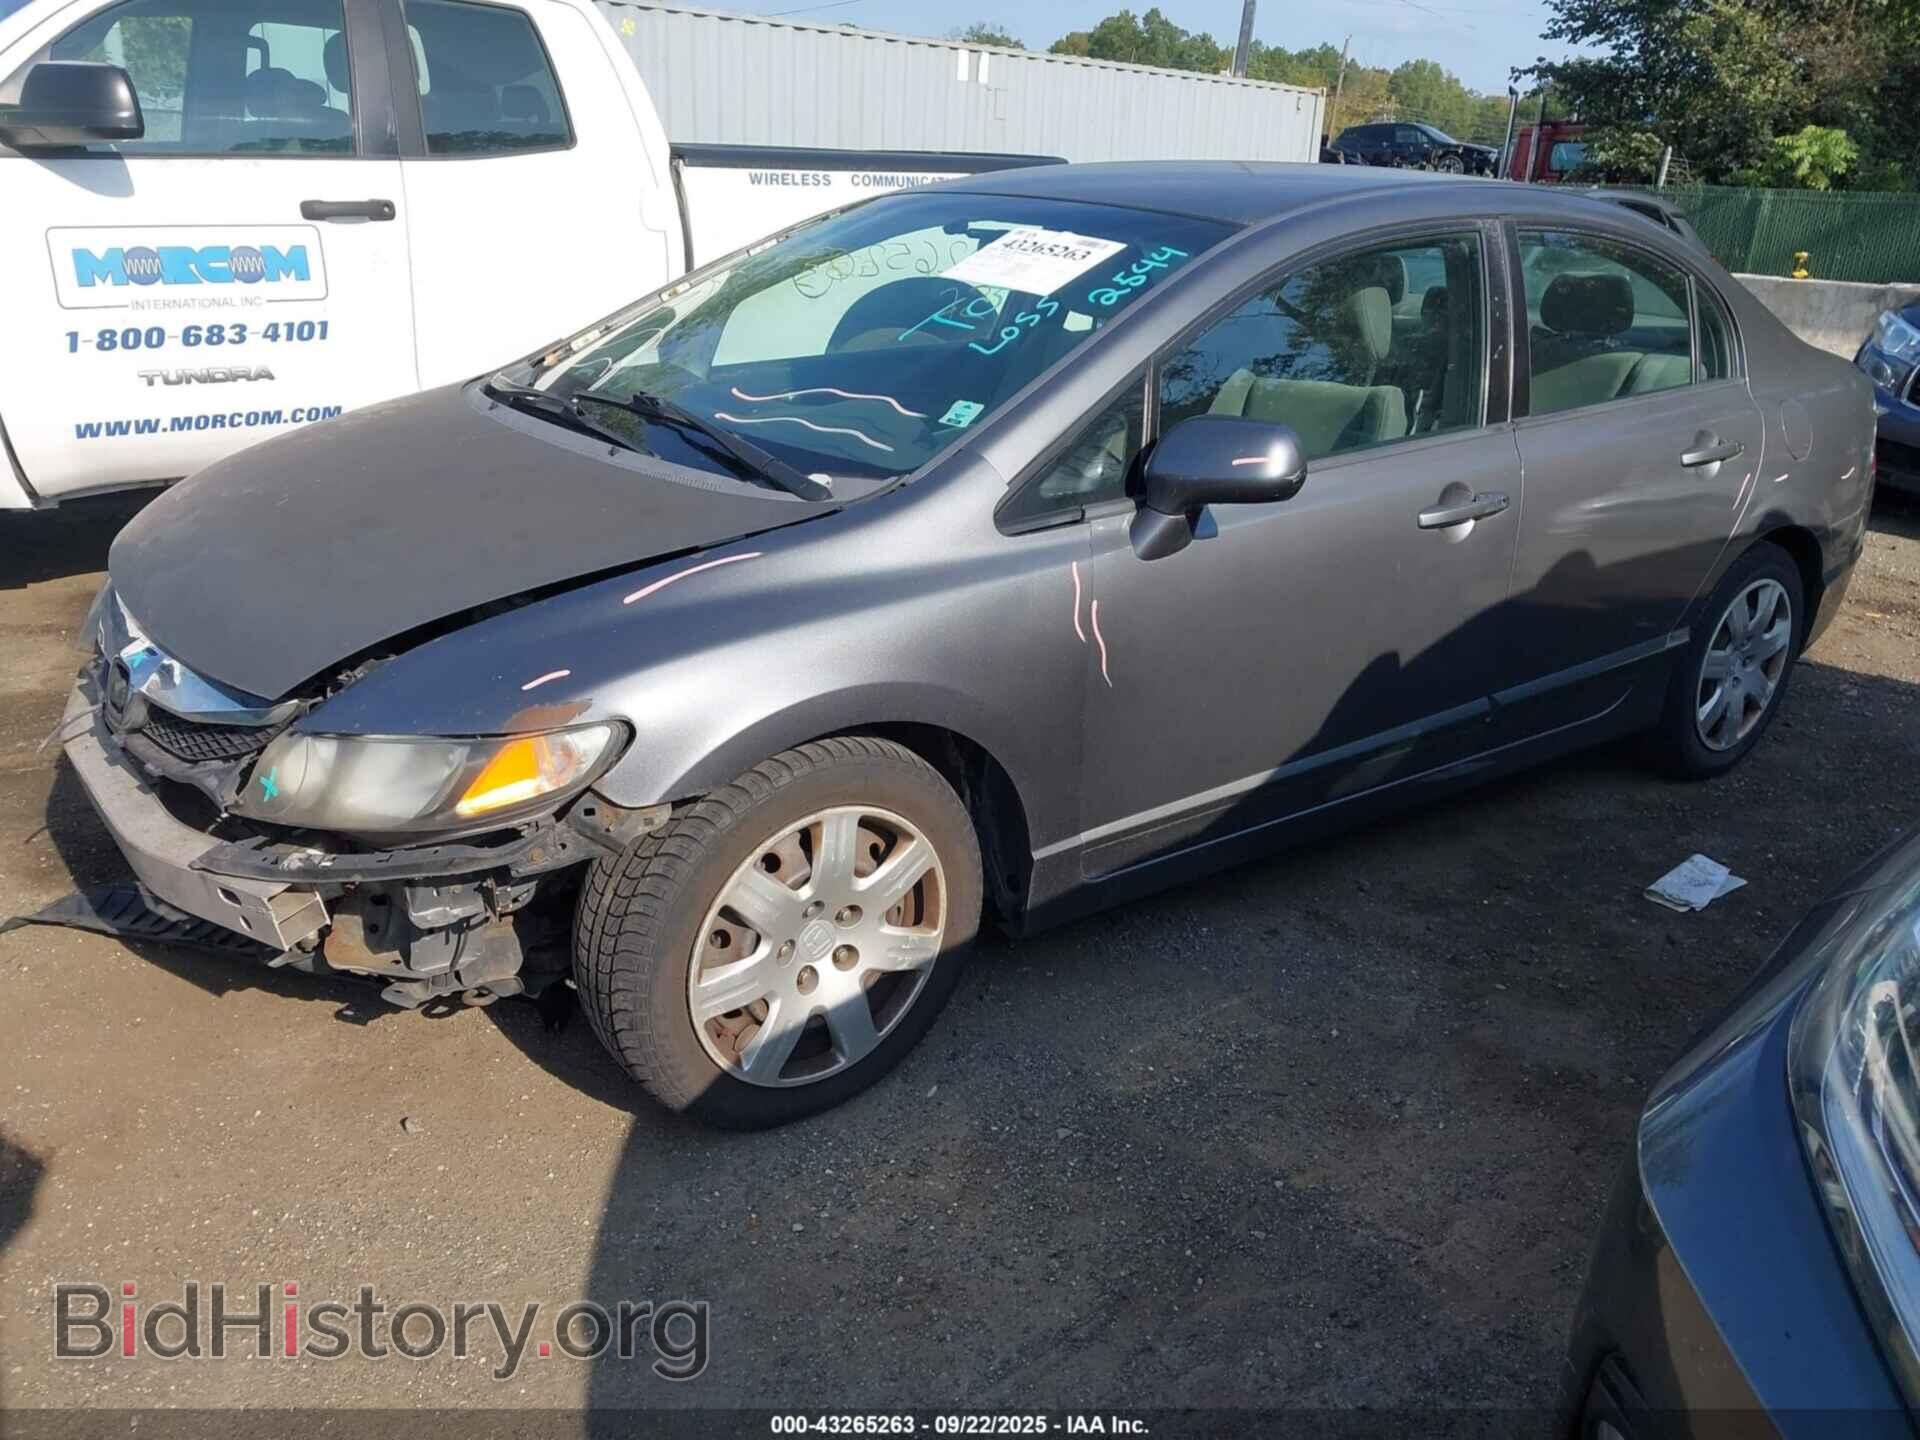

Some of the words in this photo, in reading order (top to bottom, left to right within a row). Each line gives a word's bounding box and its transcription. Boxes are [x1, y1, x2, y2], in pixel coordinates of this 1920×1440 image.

[749, 172, 832, 187] WIRELESS
[71, 245, 311, 288] MORCOM
[130, 298, 236, 312] INTERNATIONAL
[240, 295, 263, 307] INC
[65, 320, 329, 353] 1-800-683-4101
[137, 366, 276, 386] TUNDRA
[75, 405, 343, 439] WWW.MORCOM.COM
